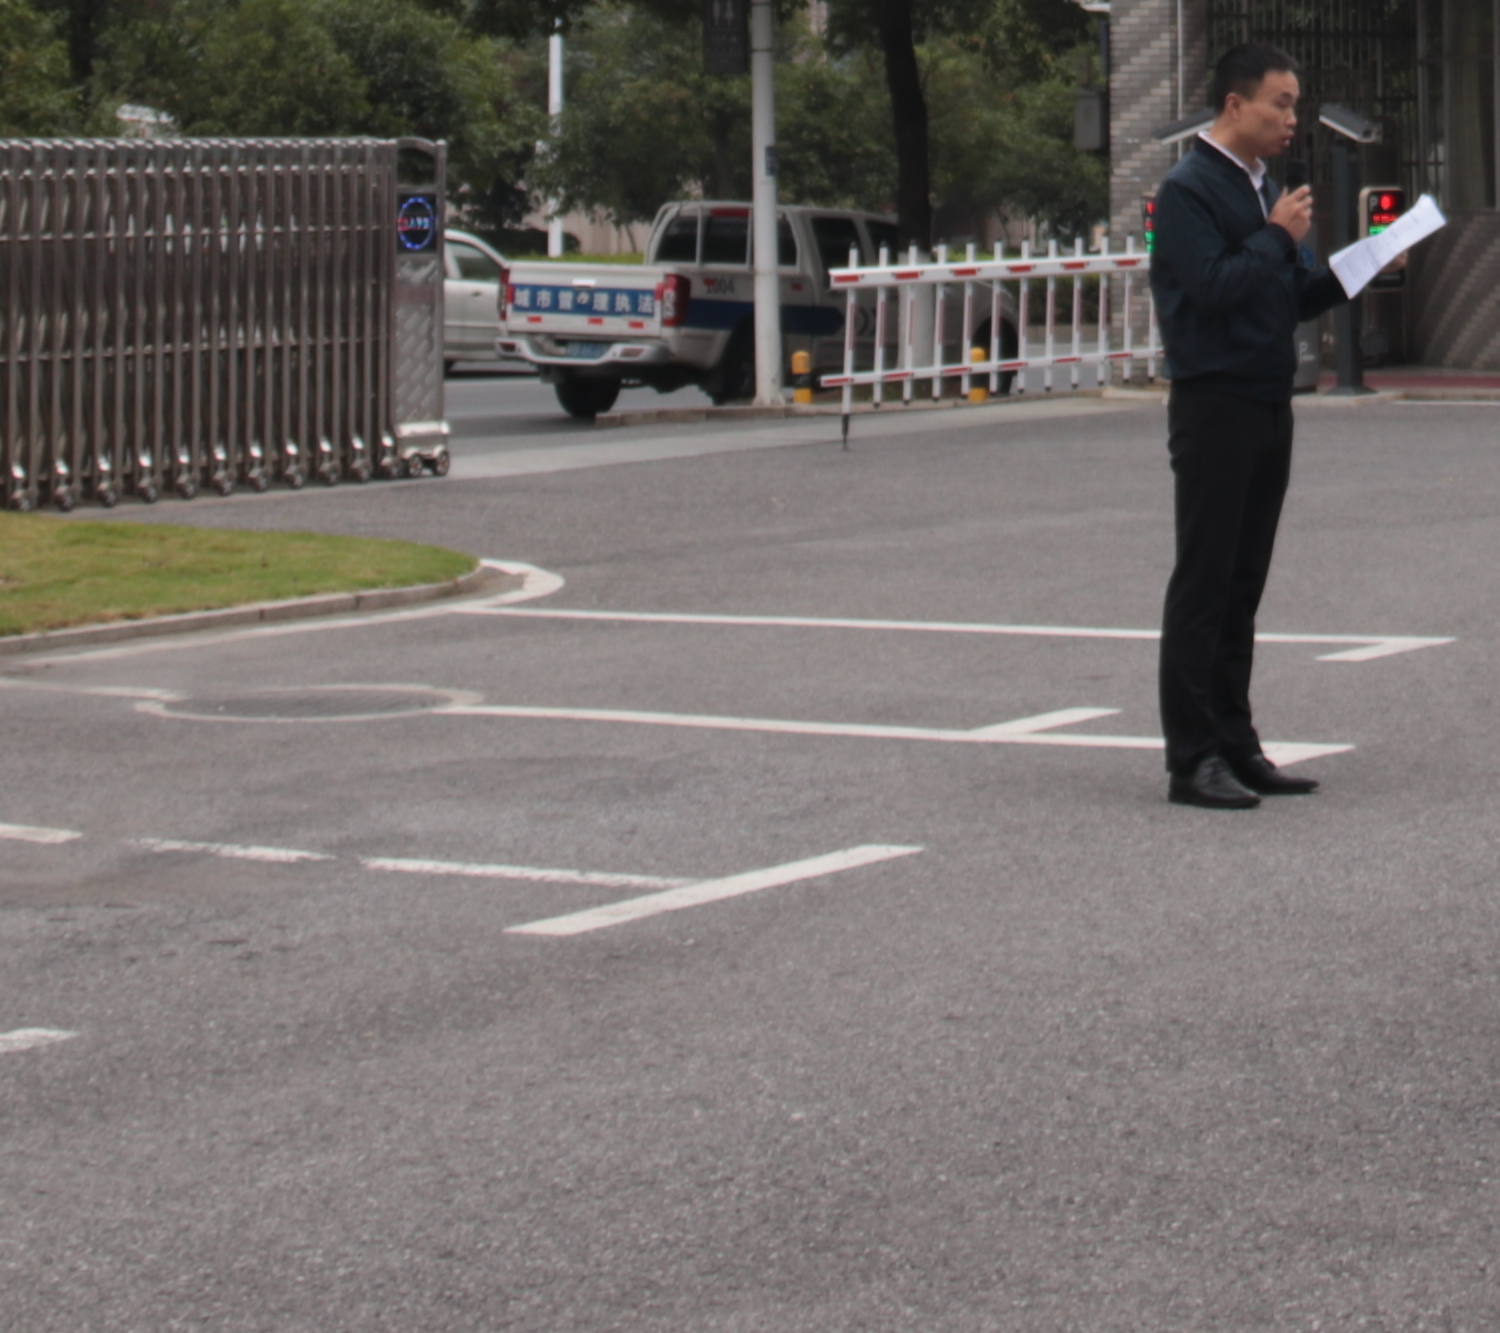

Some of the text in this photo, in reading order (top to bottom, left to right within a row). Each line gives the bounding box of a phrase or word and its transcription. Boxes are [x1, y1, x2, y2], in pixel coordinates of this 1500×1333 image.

[514, 287, 654, 314] 城市管理执法
